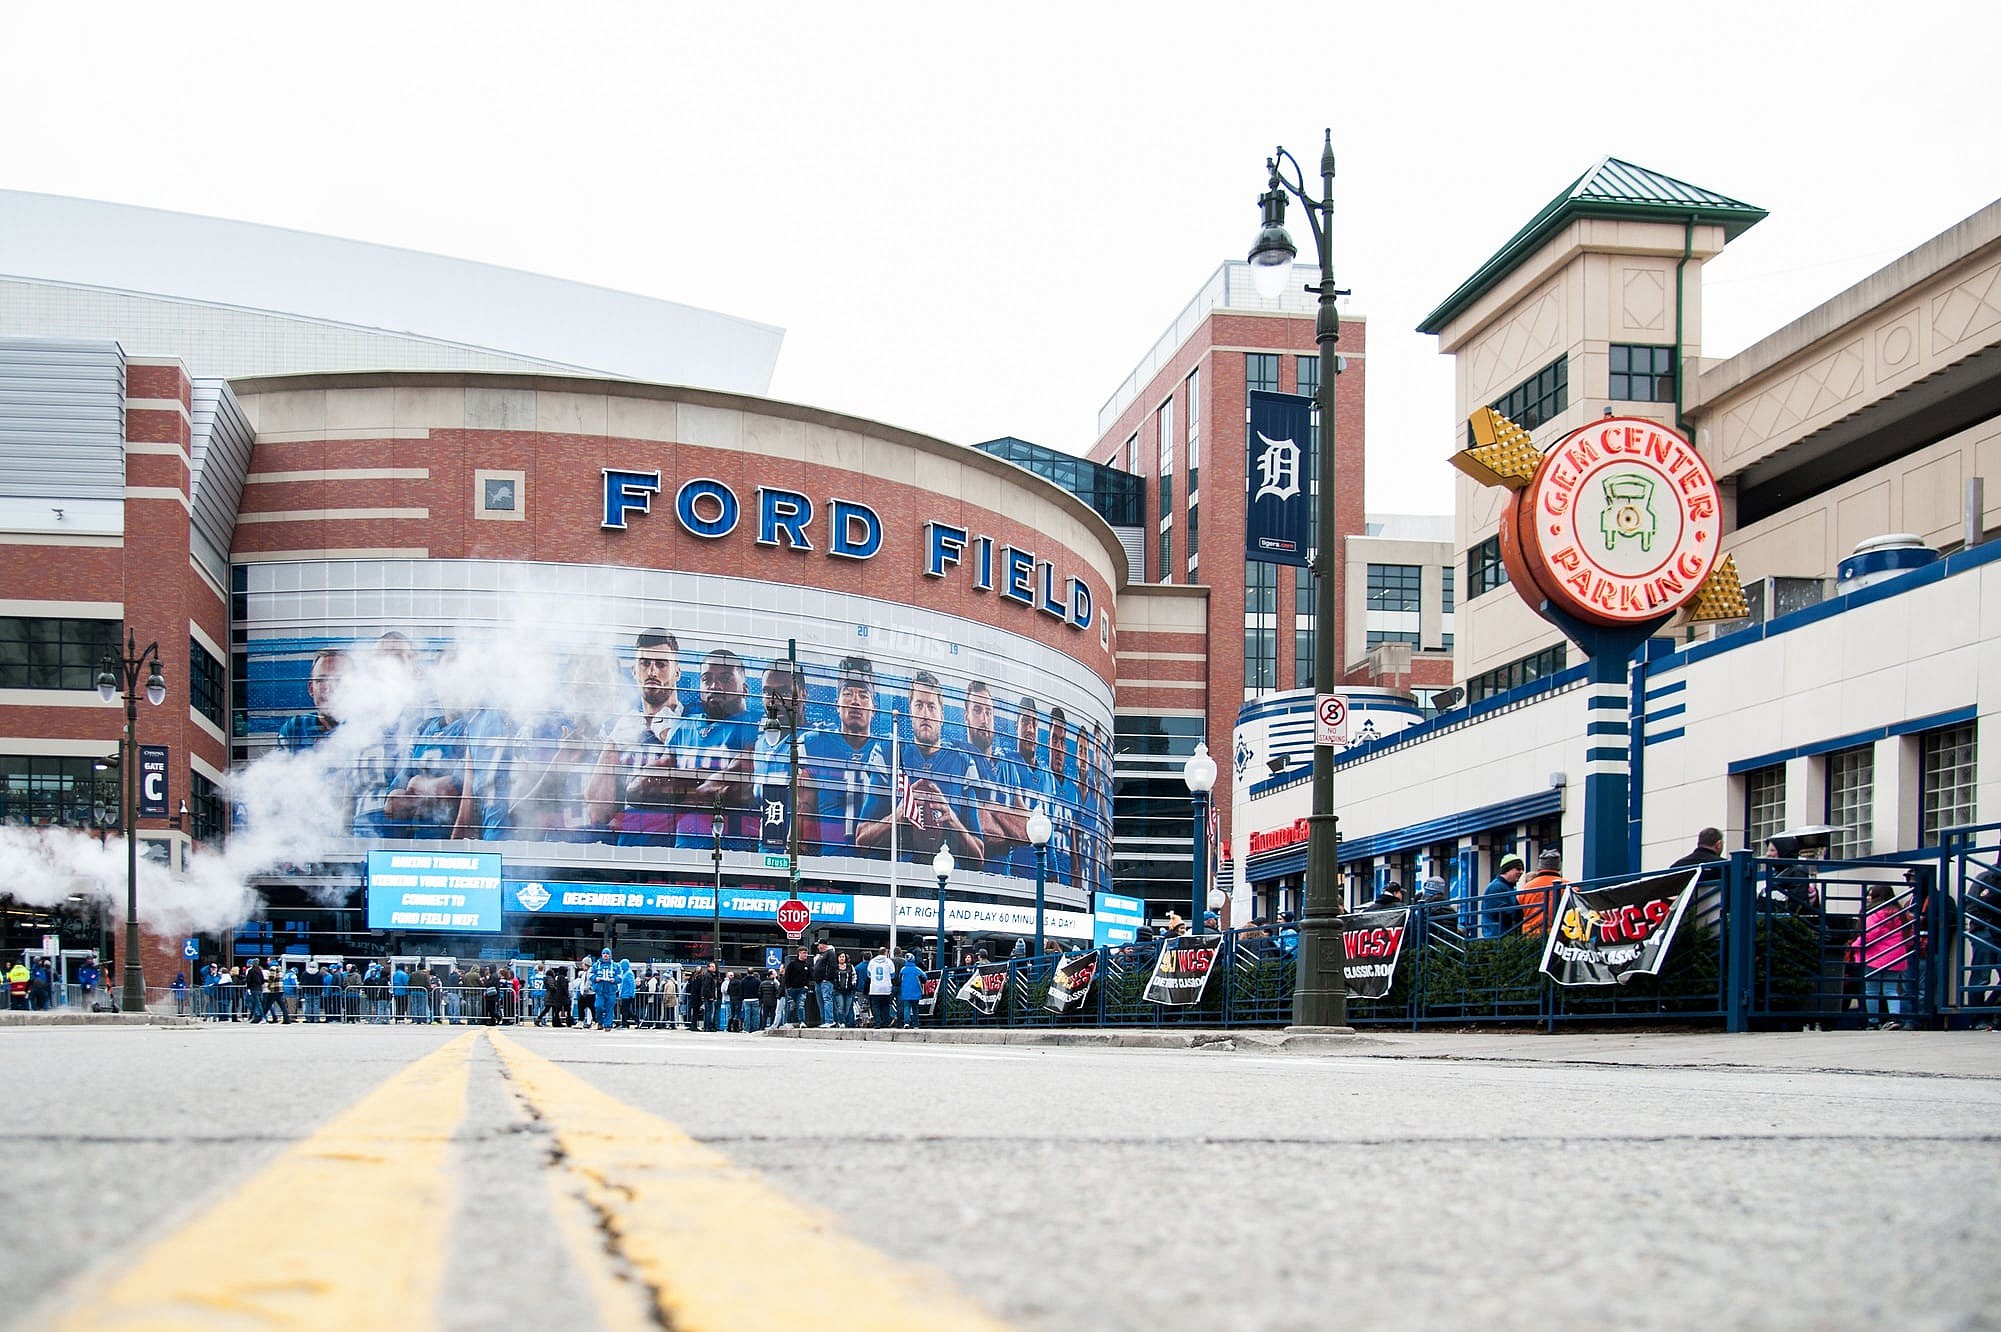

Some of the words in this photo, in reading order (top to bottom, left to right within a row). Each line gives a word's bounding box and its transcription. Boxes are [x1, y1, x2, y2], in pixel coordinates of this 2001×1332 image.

[1544, 438, 1601, 516] GEM
[1600, 427, 1714, 522] CENTER
[600, 467, 884, 561] FORD
[922, 519, 1094, 631] FIELD
[1551, 546, 1704, 611] PARKING
[857, 625, 869, 637] 20
[949, 642, 960, 656] 19
[1318, 734, 1346, 743] STANDING
[144, 762, 165, 770] GATE
[145, 773, 163, 801] C
[766, 857, 788, 867] Brush
[562, 892, 626, 907] DECEMBER
[655, 895, 687, 909] FORD
[731, 898, 778, 912] TICKETS
[821, 902, 847, 915] NOW
[780, 909, 808, 923] STOP
[914, 907, 945, 918] RIGH
[948, 909, 971, 920] AND
[974, 911, 997, 921] PLAY
[999, 913, 1010, 923] 60
[1012, 914, 1049, 926] MINUS
[1051, 918, 1056, 927] A
[1058, 919, 1076, 928] DAY!
[1342, 927, 1404, 960] WCSX
[1343, 964, 1375, 979] CLASSIC
